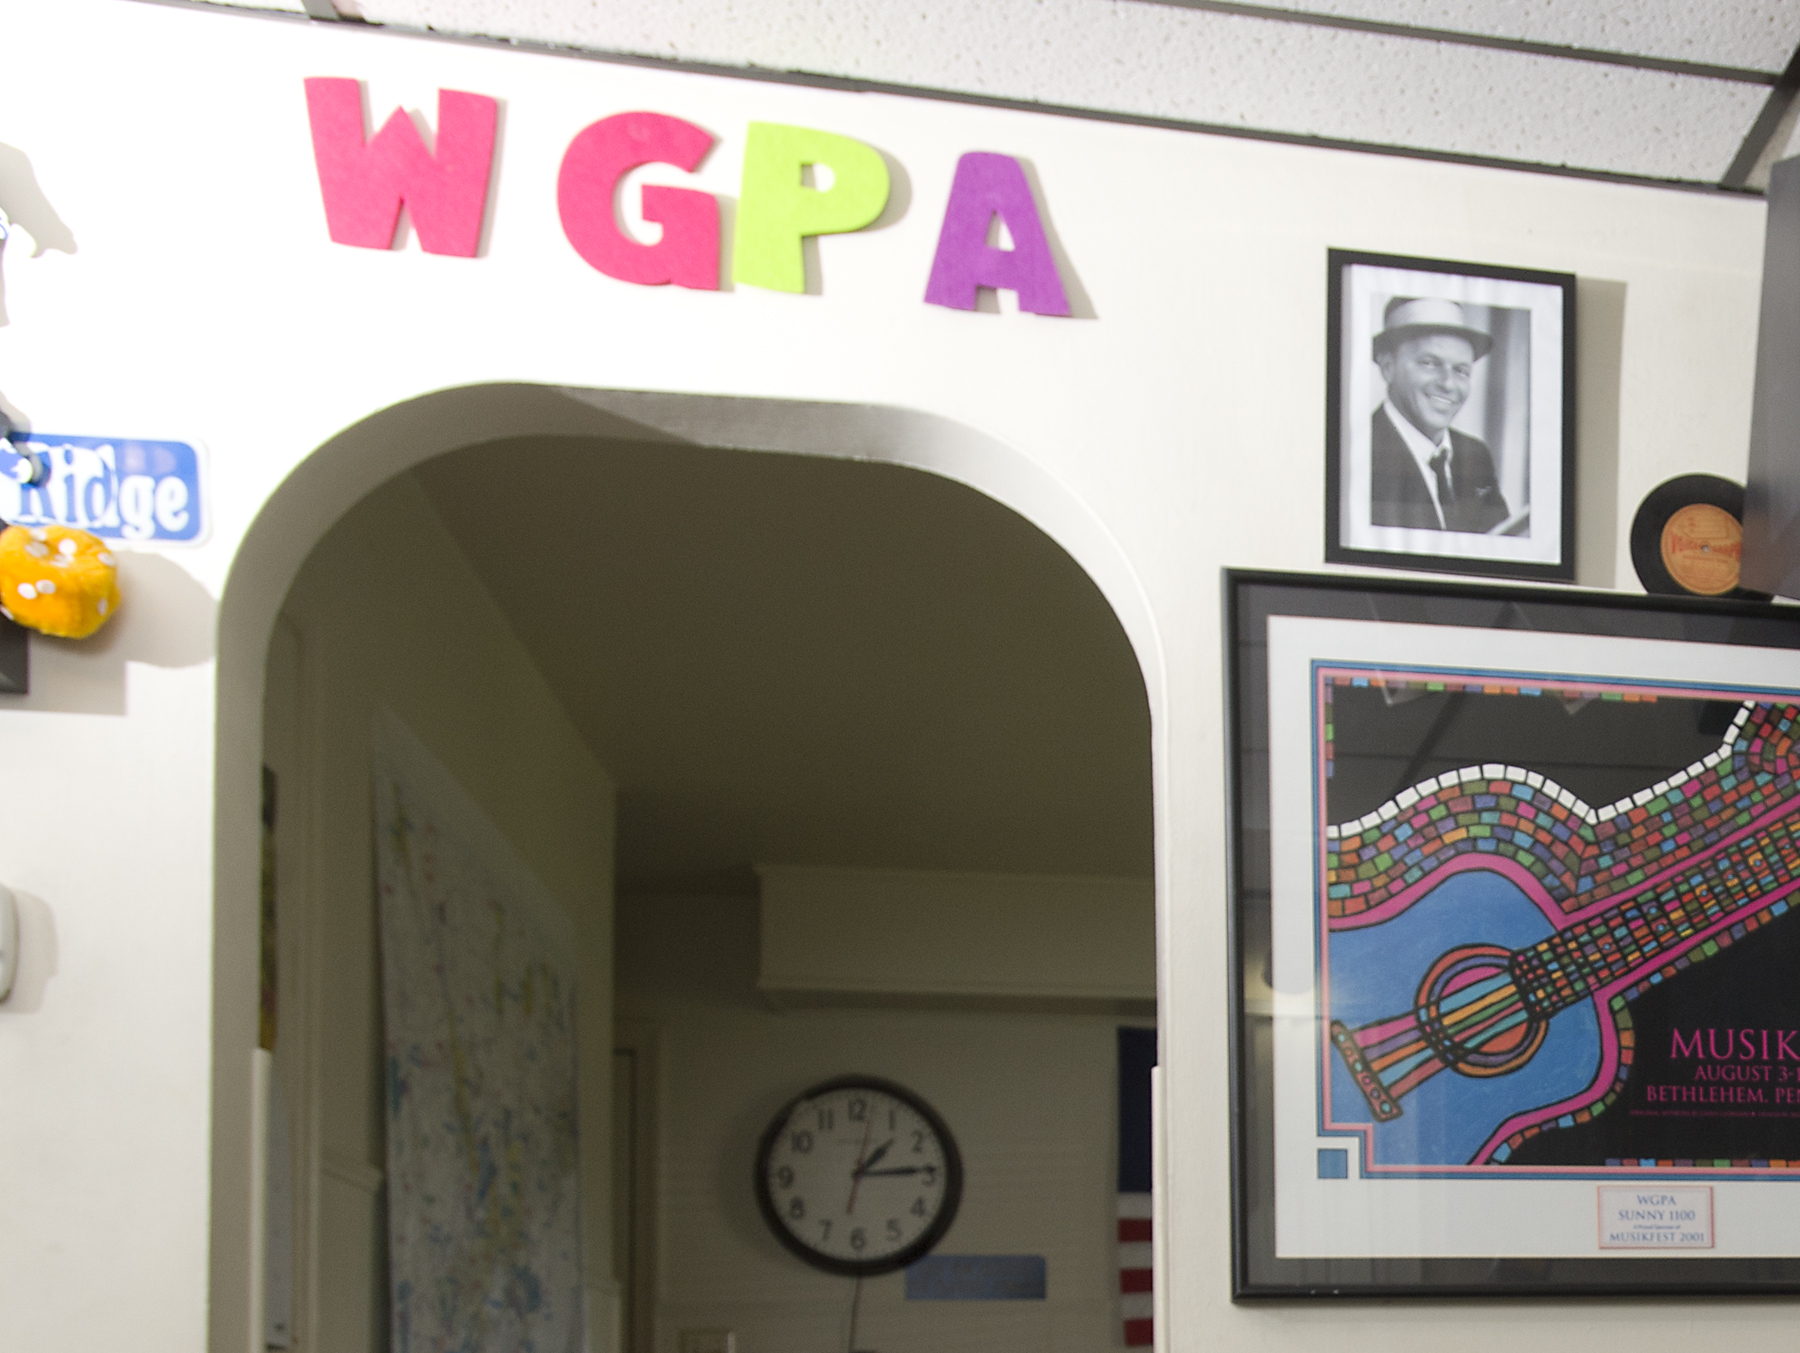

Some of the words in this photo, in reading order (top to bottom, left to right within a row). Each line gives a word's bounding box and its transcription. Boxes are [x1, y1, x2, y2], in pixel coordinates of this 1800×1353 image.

[304, 77, 1072, 317] WGPA
[1694, 1065, 1772, 1082] AUGUST
[1637, 1194, 1676, 1206] WGPA
[1618, 1209, 1666, 1221] SUNNY
[1669, 1210, 1696, 1221] 1100
[1610, 1232, 1676, 1242] MUSIKFEST
[1680, 1233, 1704, 1242] 2001
